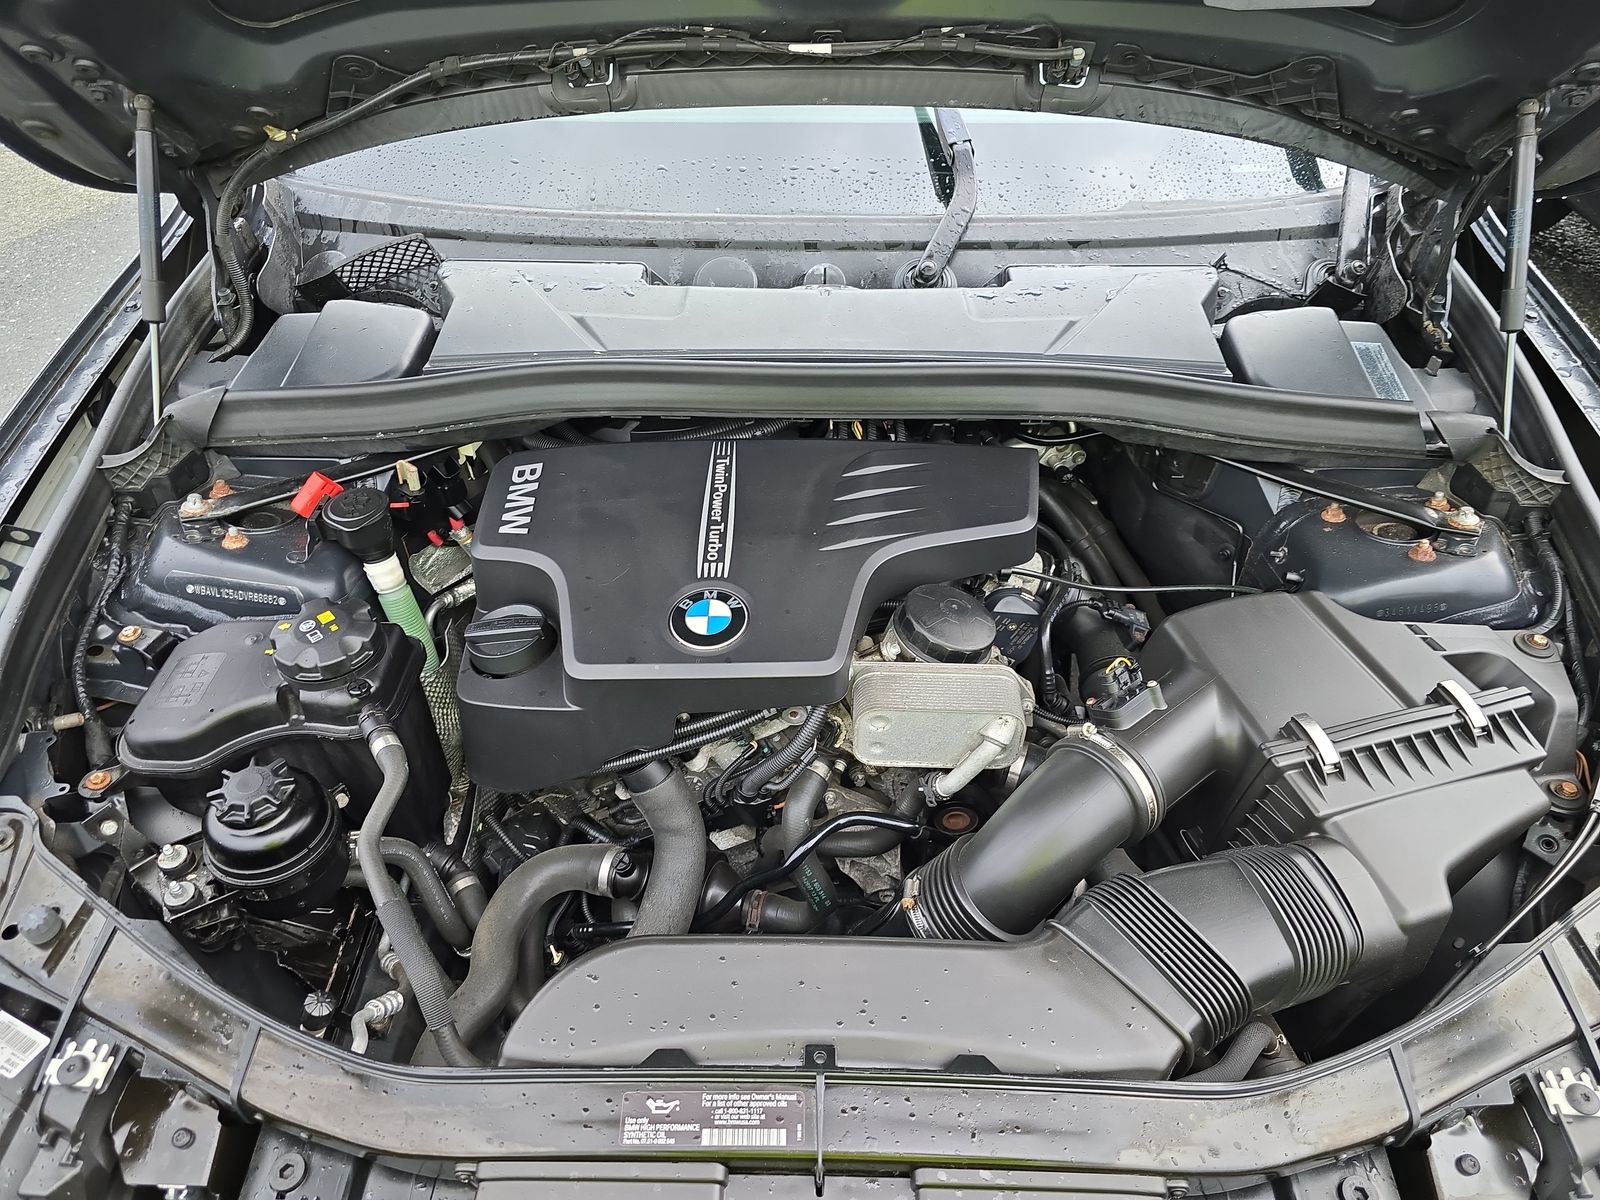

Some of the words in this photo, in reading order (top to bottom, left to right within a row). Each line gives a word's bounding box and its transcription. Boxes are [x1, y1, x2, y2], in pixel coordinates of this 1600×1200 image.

[498, 462, 543, 534] BMW
[710, 456, 730, 522] TwinPower
[706, 522, 725, 561] Turbo
[637, 1117, 650, 1126] only
[749, 1101, 777, 1109] approved
